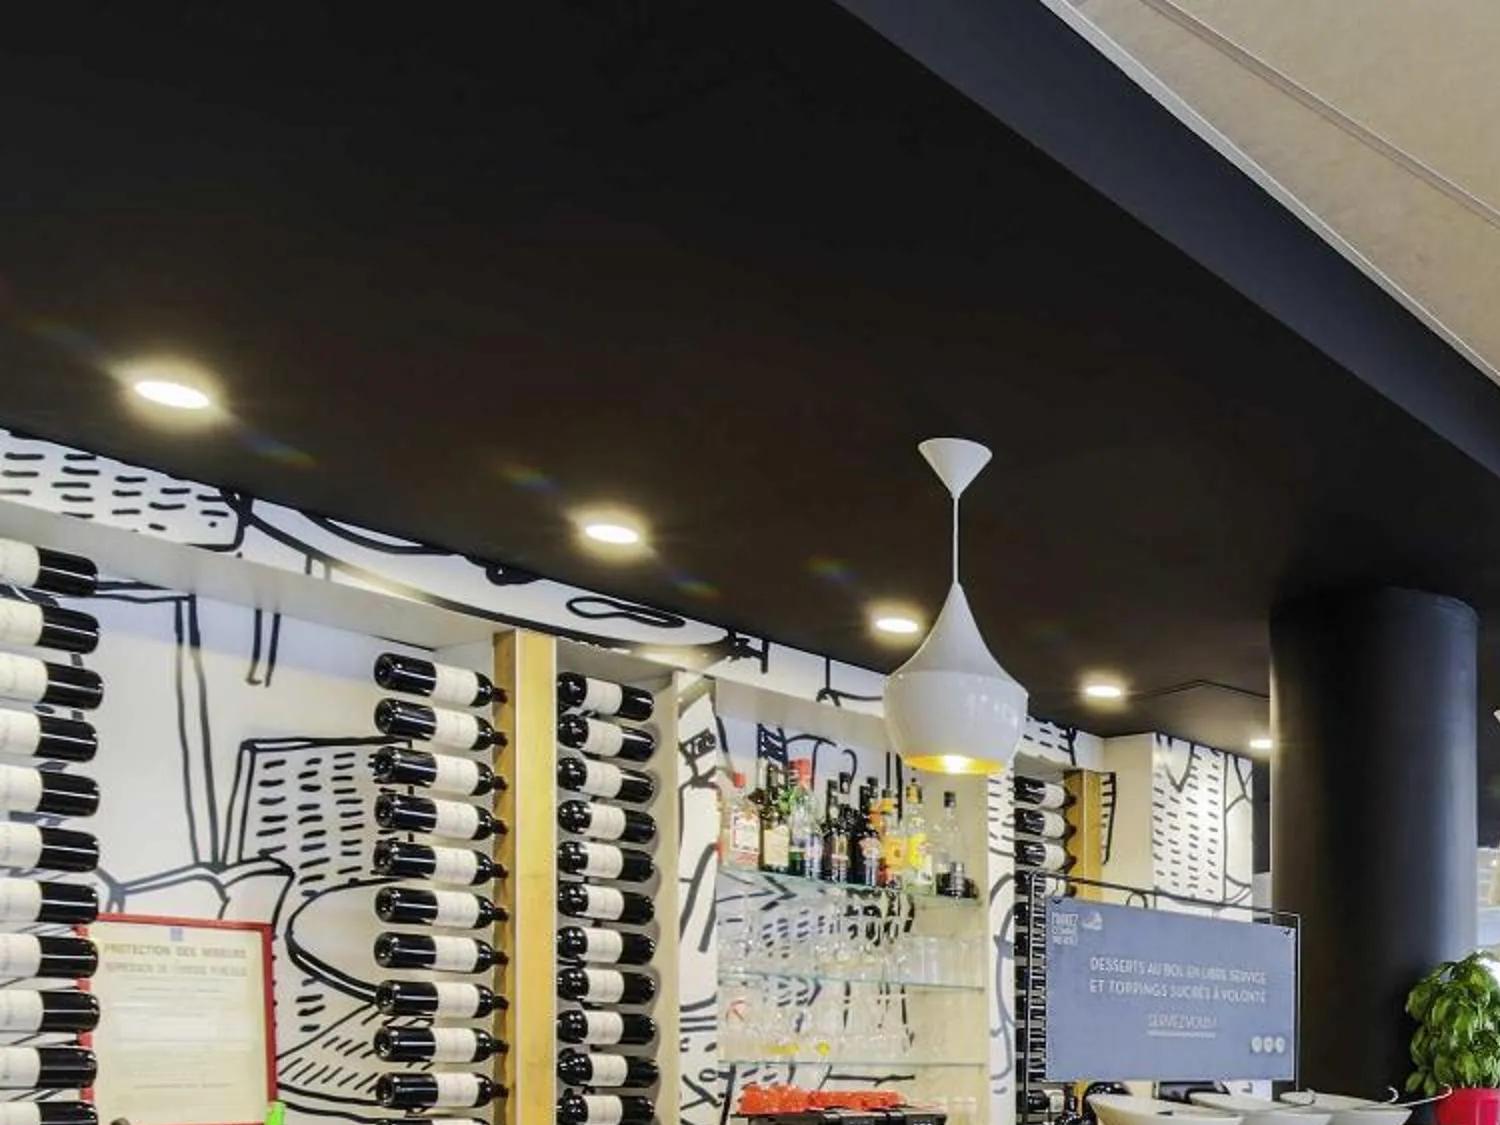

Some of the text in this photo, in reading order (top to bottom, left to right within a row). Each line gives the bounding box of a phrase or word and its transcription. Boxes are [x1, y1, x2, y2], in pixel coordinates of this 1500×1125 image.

[1090, 956, 1145, 975] DESSERTS
[1090, 978, 1104, 993] ET
[1108, 979, 1168, 998] TOPPINGS
